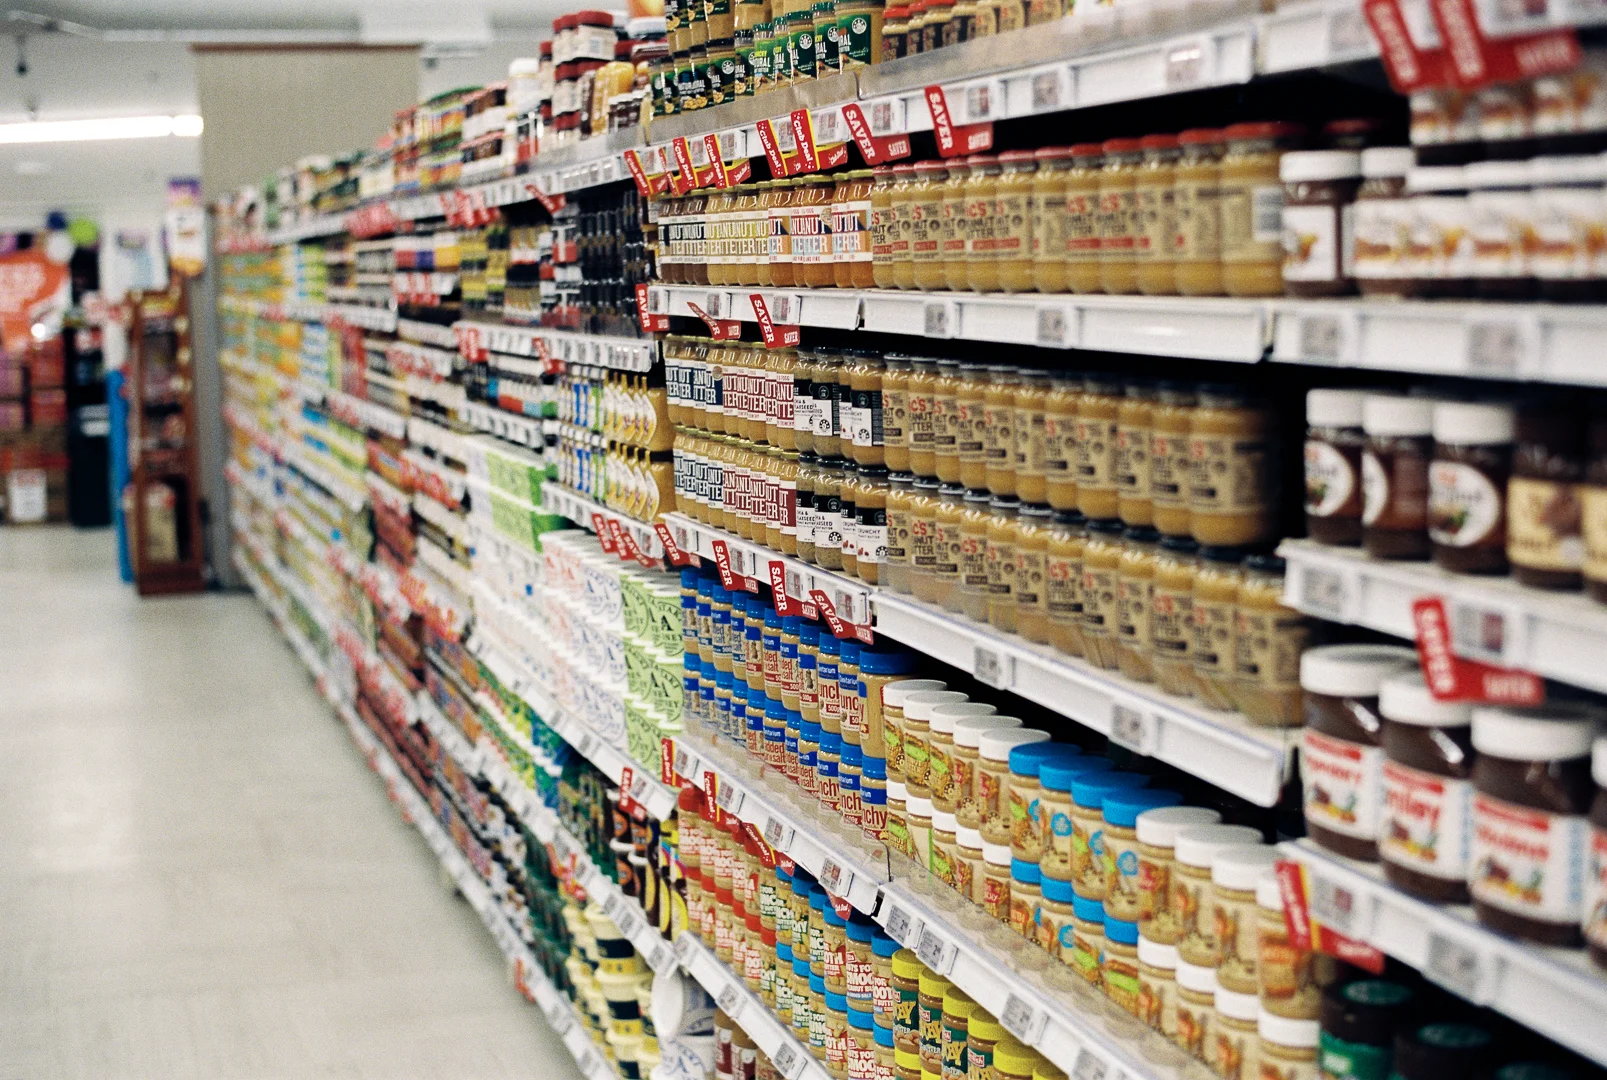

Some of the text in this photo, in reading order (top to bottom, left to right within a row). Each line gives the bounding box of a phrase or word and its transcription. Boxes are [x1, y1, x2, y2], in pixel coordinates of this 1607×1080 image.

[845, 109, 875, 159] SAVER
[929, 92, 953, 150] SAVER
[759, 129, 781, 169] Club Deal
[793, 120, 813, 164] Club Deal
[888, 140, 907, 156] SAVER
[674, 145, 693, 181] Club Deal
[706, 144, 717, 162] Club
[714, 161, 723, 180] Deal
[638, 289, 650, 328] SAVER
[754, 299, 775, 344] SAVER
[784, 331, 799, 344] SAVER
[657, 527, 680, 561] SAVER
[715, 546, 733, 586] SAVER
[744, 578, 757, 590] SAVER
[771, 566, 787, 611] SAVER
[802, 604, 816, 618] SAVER
[814, 594, 844, 634] SAVER
[855, 626, 871, 642] SAVER
[707, 795, 715, 813] Deal
[745, 827, 770, 857] Club Deal
